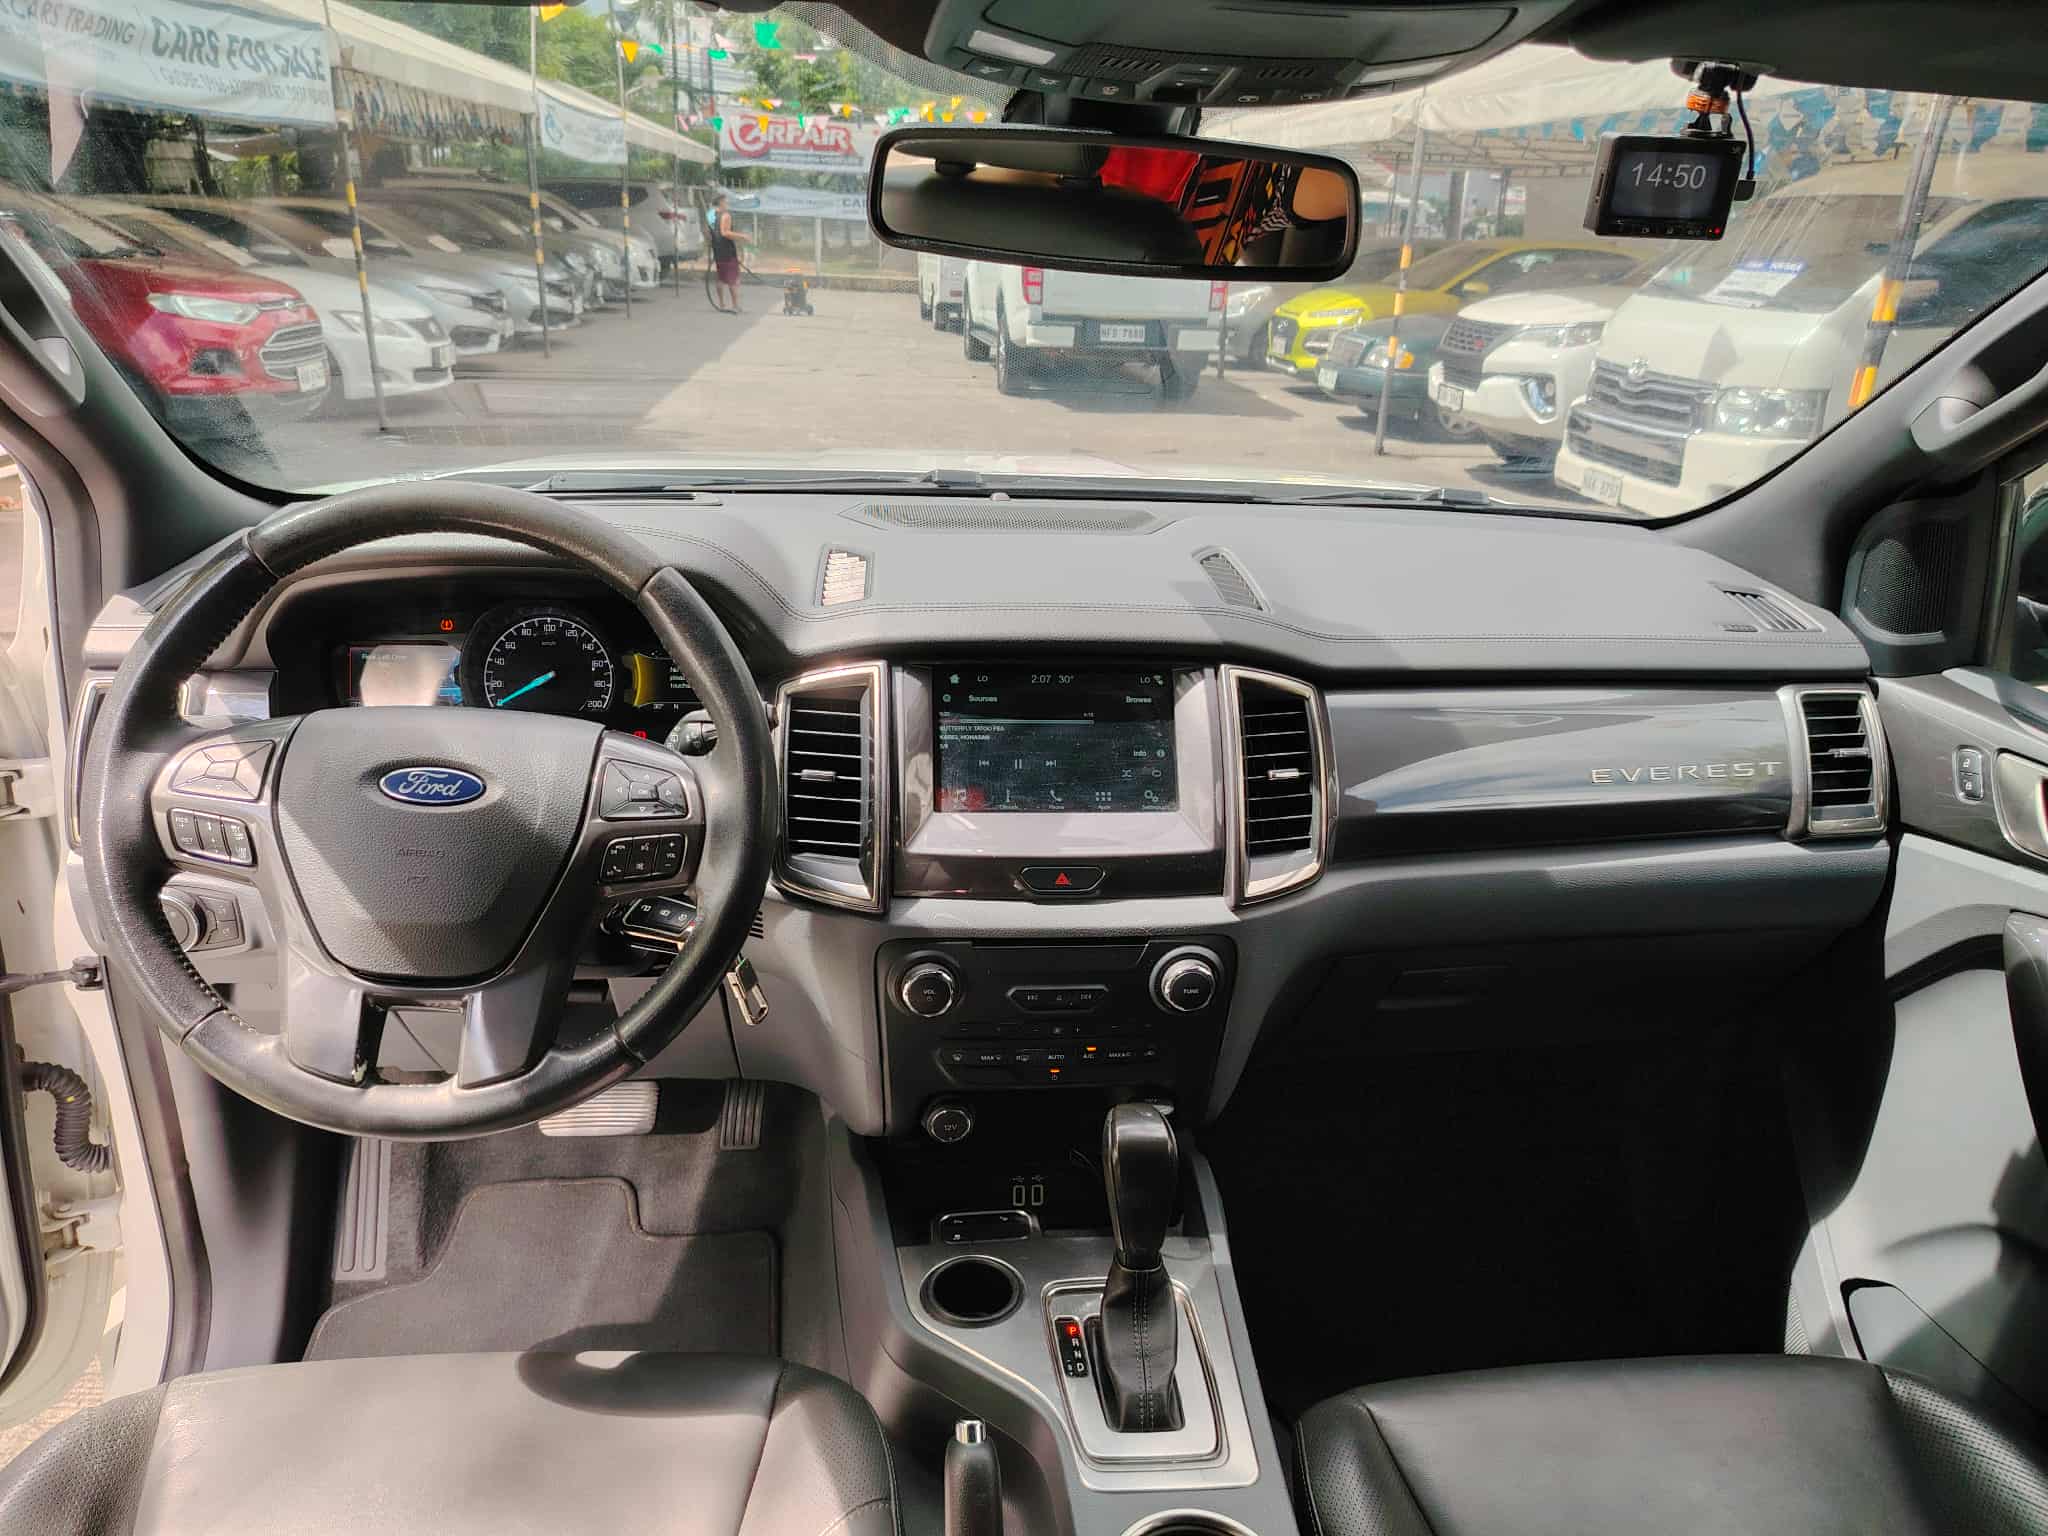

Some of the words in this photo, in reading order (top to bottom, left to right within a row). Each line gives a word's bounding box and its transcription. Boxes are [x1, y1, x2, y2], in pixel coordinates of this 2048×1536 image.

[10, 0, 64, 26] CARS
[63, 7, 137, 44] TRADING
[150, 16, 220, 68] CARS
[225, 33, 275, 77] FOR
[274, 45, 327, 82] SALE
[1631, 161, 1707, 190] 14:50
[842, 200, 867, 209] CA
[521, 628, 532, 636] 80
[543, 624, 556, 632] 100
[565, 629, 578, 637] 120
[582, 642, 595, 651] 140
[494, 658, 505, 666] 40
[591, 660, 604, 668] 160
[977, 674, 989, 682] LO
[1031, 674, 1051, 684] 2:07
[1140, 676, 1151, 684] LO
[492, 680, 503, 688] 20
[593, 680, 606, 688] 180
[587, 700, 603, 708] 200
[1133, 749, 1147, 757] Info
[1591, 761, 1784, 784] EVEREST
[398, 771, 463, 796] Ford
[1070, 1326, 1077, 1335] P
[1072, 1338, 1080, 1347] R
[1076, 1362, 1085, 1372] D
